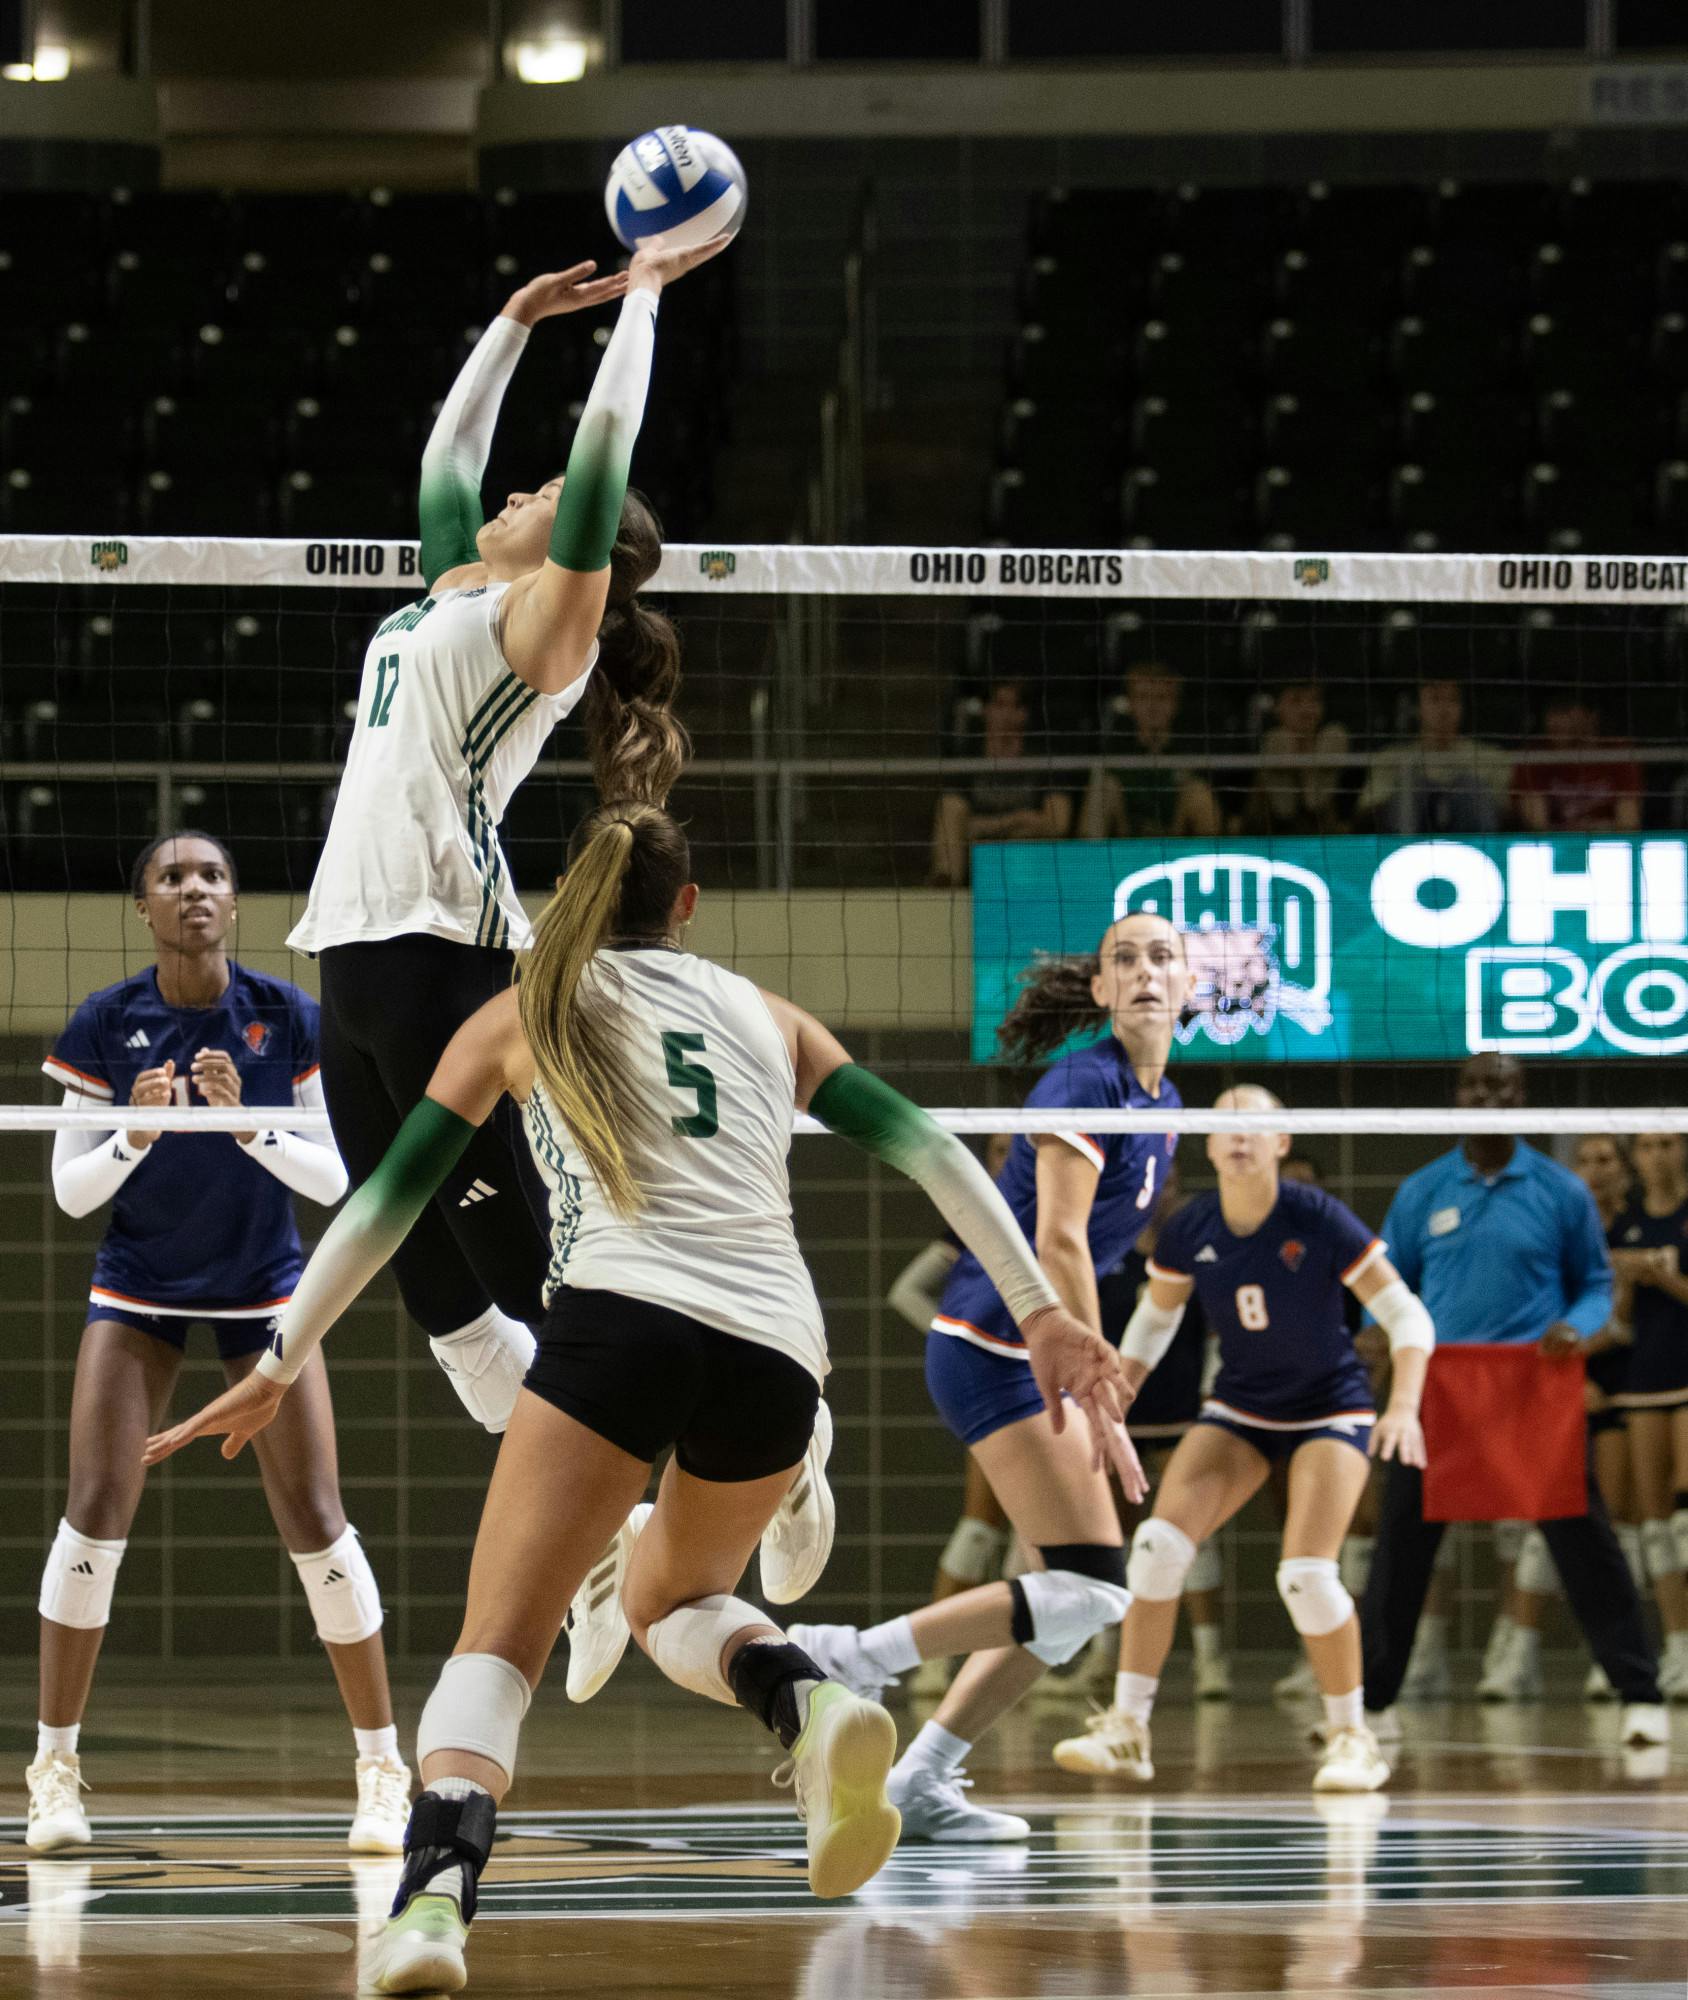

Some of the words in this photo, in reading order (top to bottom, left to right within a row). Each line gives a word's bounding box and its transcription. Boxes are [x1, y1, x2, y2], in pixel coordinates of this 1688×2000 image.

[306, 543, 384, 575] OHIO
[910, 553, 986, 584] OHIO
[1000, 554, 1122, 585] BOBCATS
[1498, 559, 1572, 590] OHIO
[367, 653, 400, 728] 12
[1371, 840, 1687, 948] OHI
[1466, 944, 1688, 1055] BO
[660, 1031, 719, 1138] 5
[1234, 1283, 1270, 1331] 8
